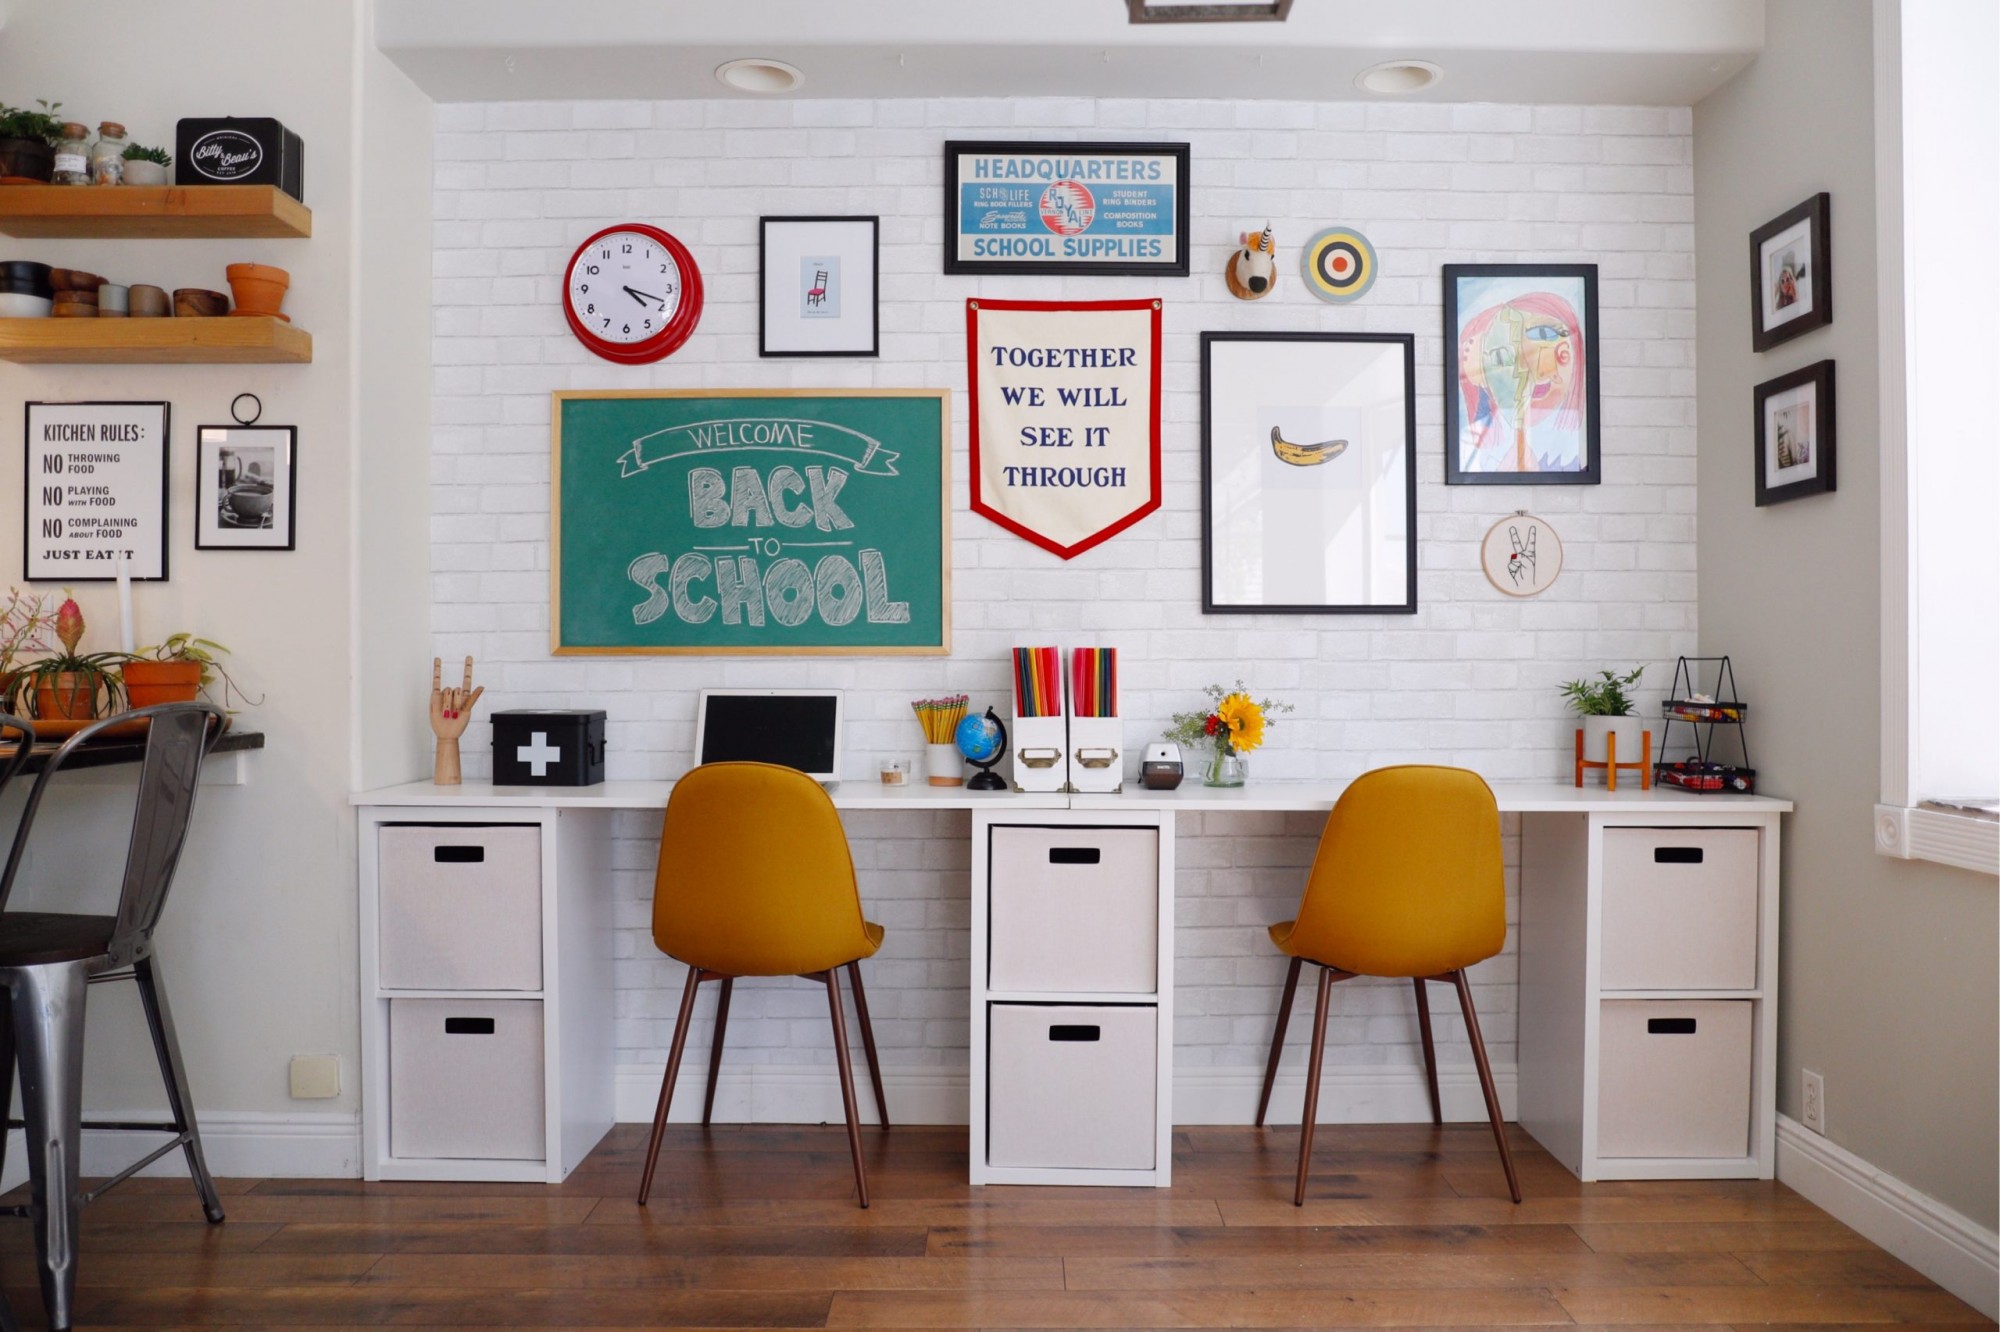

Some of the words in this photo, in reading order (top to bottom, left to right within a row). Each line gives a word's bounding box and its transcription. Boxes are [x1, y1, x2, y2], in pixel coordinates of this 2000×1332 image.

[196, 144, 222, 158] Bitty
[221, 149, 257, 166] Beau's
[975, 158, 1161, 180] HEADQUARTERS
[1112, 190, 1148, 198] STUDENT
[1102, 198, 1121, 206] RING
[1124, 198, 1157, 206] BINDERS
[1103, 212, 1157, 220] COMPOSITION
[622, 244, 633, 254] 12
[974, 238, 1056, 257] SCHOOL
[1063, 238, 1162, 257] SUPPLIES
[602, 249, 611, 260] 11
[646, 249, 650, 259] 1
[586, 265, 600, 275] 10
[660, 264, 667, 273] 2
[580, 284, 589, 294] 9
[665, 283, 673, 294] 3
[587, 303, 595, 314] 8
[603, 318, 611, 328] 7
[622, 323, 631, 334] 6
[643, 319, 651, 329] 5
[990, 346, 1138, 368] TOGETHER
[1000, 387, 1046, 407] WE
[1056, 387, 1128, 407] WILL
[44, 424, 95, 441] KITCHEN
[101, 424, 144, 441] RULES:
[686, 422, 814, 448] WELCOME
[1020, 426, 1074, 447] SEE
[1085, 426, 1110, 447] IT
[43, 454, 63, 474] NO
[68, 454, 120, 463] THROWING
[68, 465, 95, 474] FOOD
[1002, 466, 1127, 488] THROUGH
[43, 486, 63, 506] NO
[68, 486, 110, 495] PLAYING
[89, 497, 116, 506] FOOD
[687, 465, 855, 532] BACK
[43, 518, 63, 538] NO
[68, 518, 138, 527] COMPLAINING
[96, 529, 123, 538] FOOD
[748, 537, 781, 556] TO
[43, 550, 80, 560] JUST
[86, 550, 114, 560] EAT
[628, 548, 911, 627] SCHOOL
